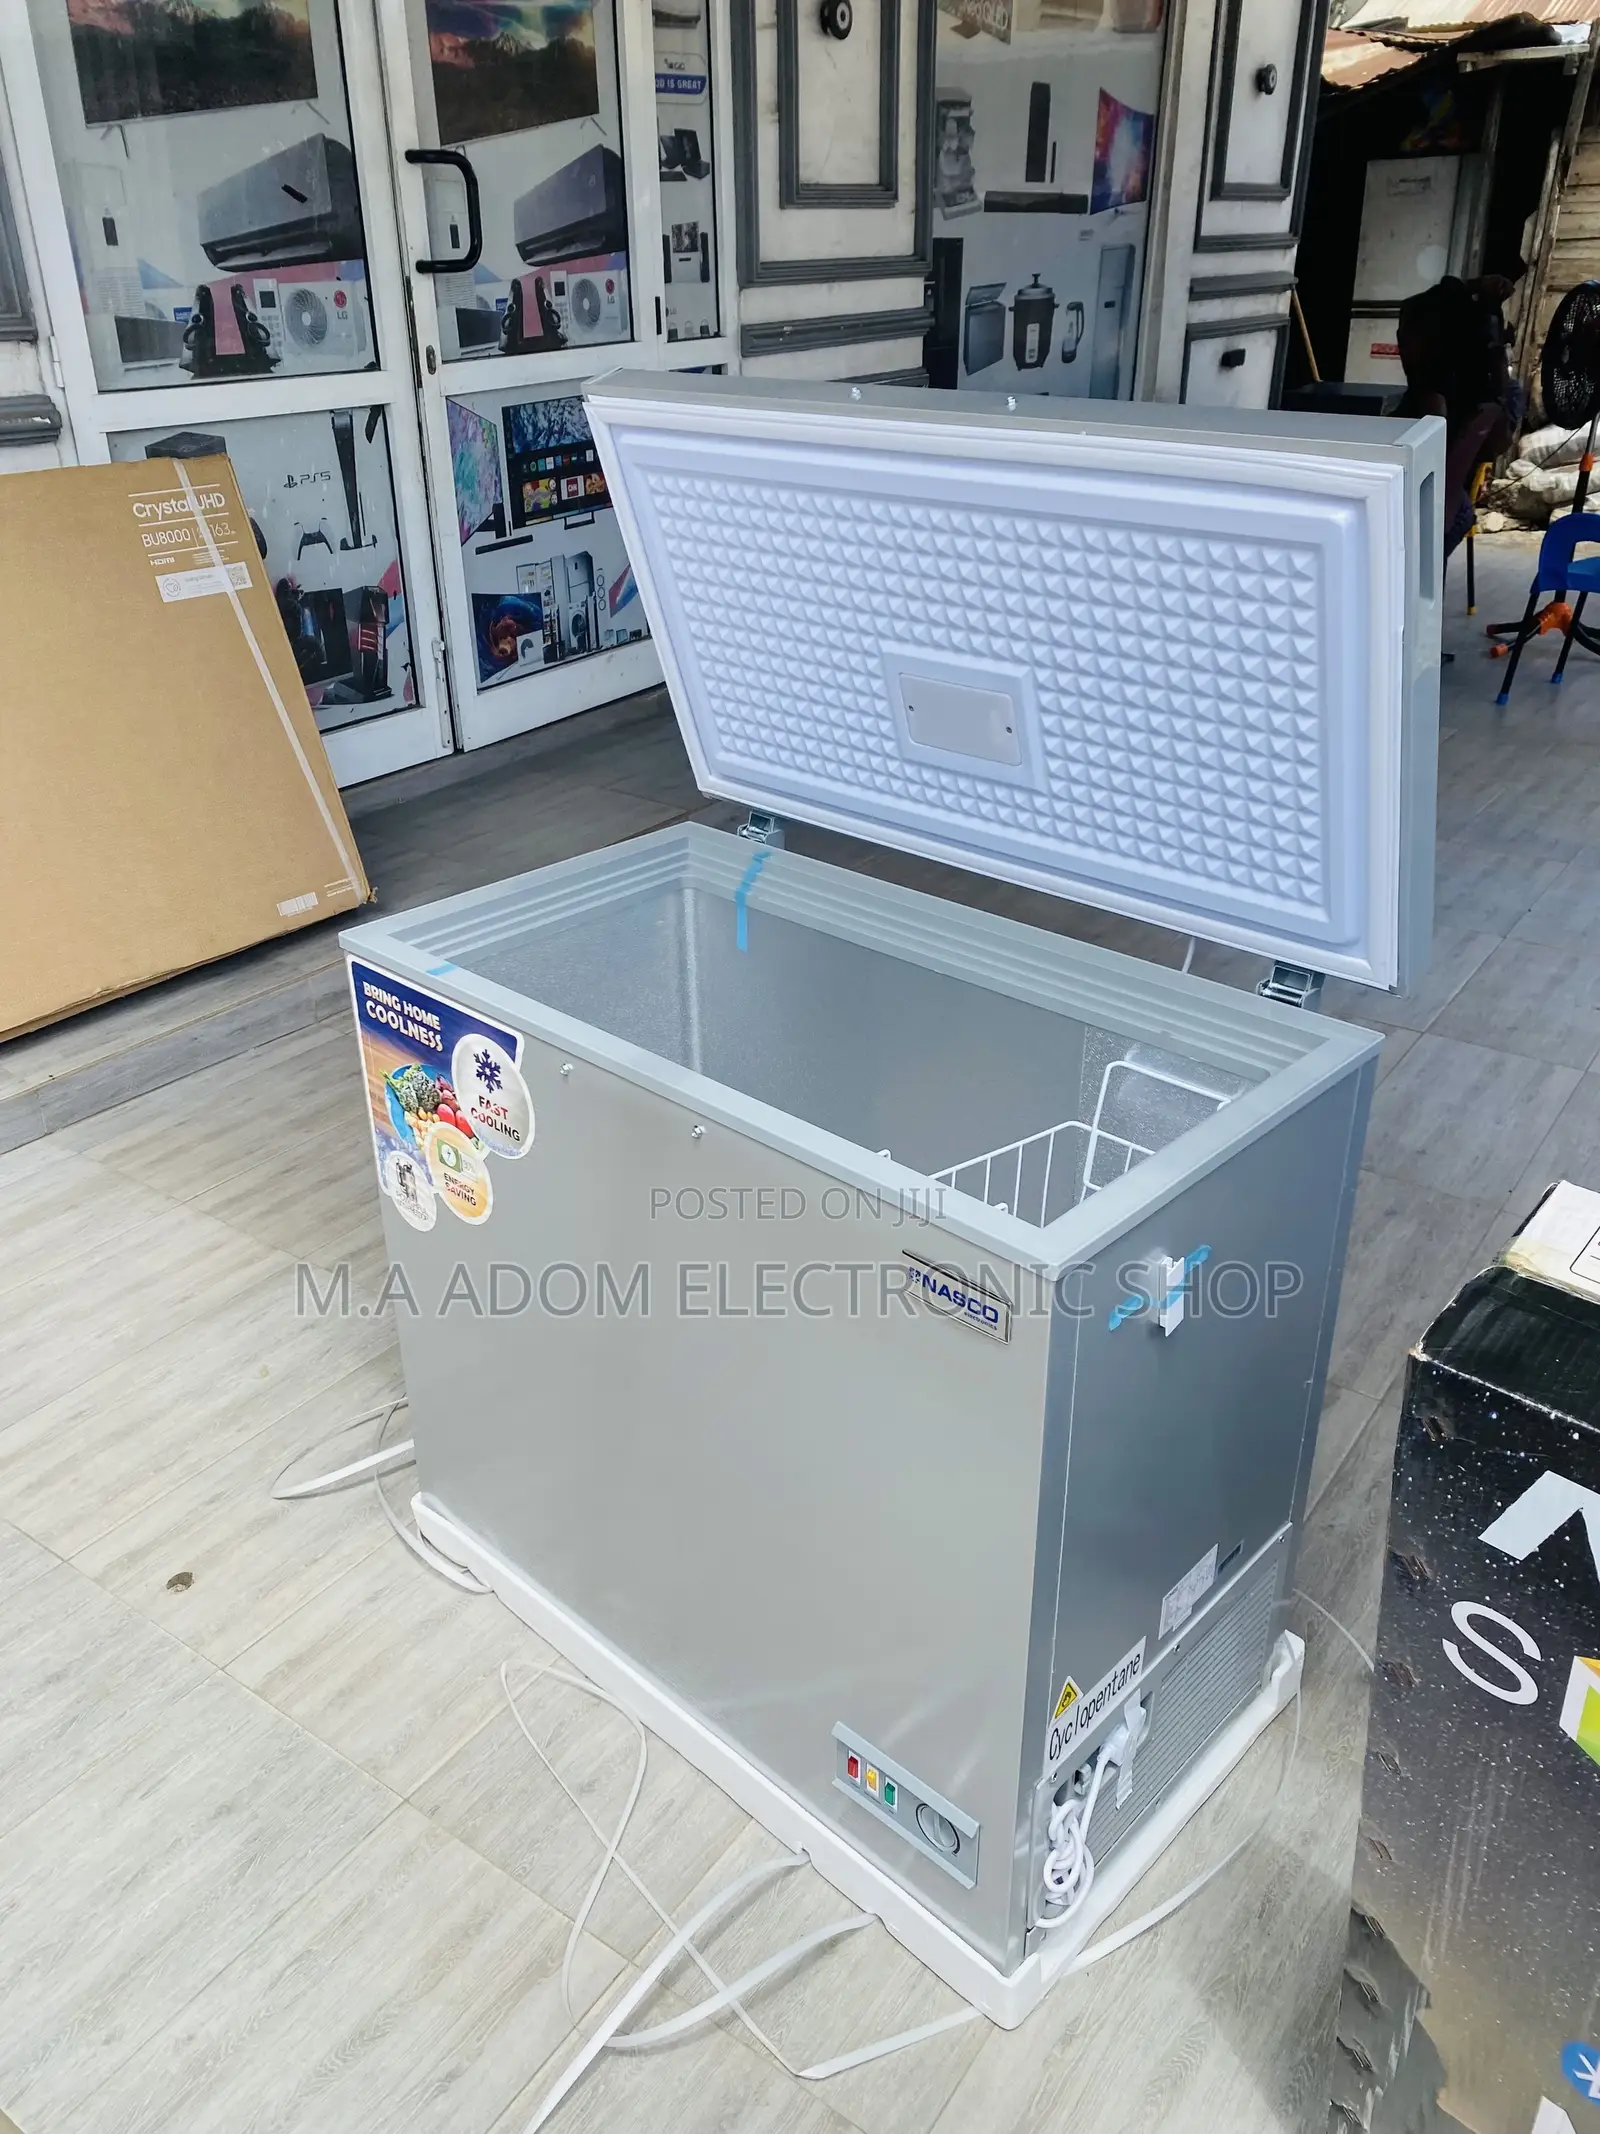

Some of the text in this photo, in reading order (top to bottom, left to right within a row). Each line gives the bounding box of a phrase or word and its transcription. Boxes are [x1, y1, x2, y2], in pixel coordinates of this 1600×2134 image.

[677, 79, 702, 90] GREAT
[336, 310, 348, 320] LG
[300, 470, 331, 485] PS5
[141, 528, 191, 548] BU8000
[362, 981, 441, 1031] BRING HOME
[366, 1000, 443, 1052] COOLNESS
[479, 1095, 508, 1120] FAST
[471, 1107, 521, 1142] COOLING
[445, 1181, 477, 1207] SAVING
[922, 1273, 999, 1324] NASCO
[1442, 1601, 1542, 1706] S
